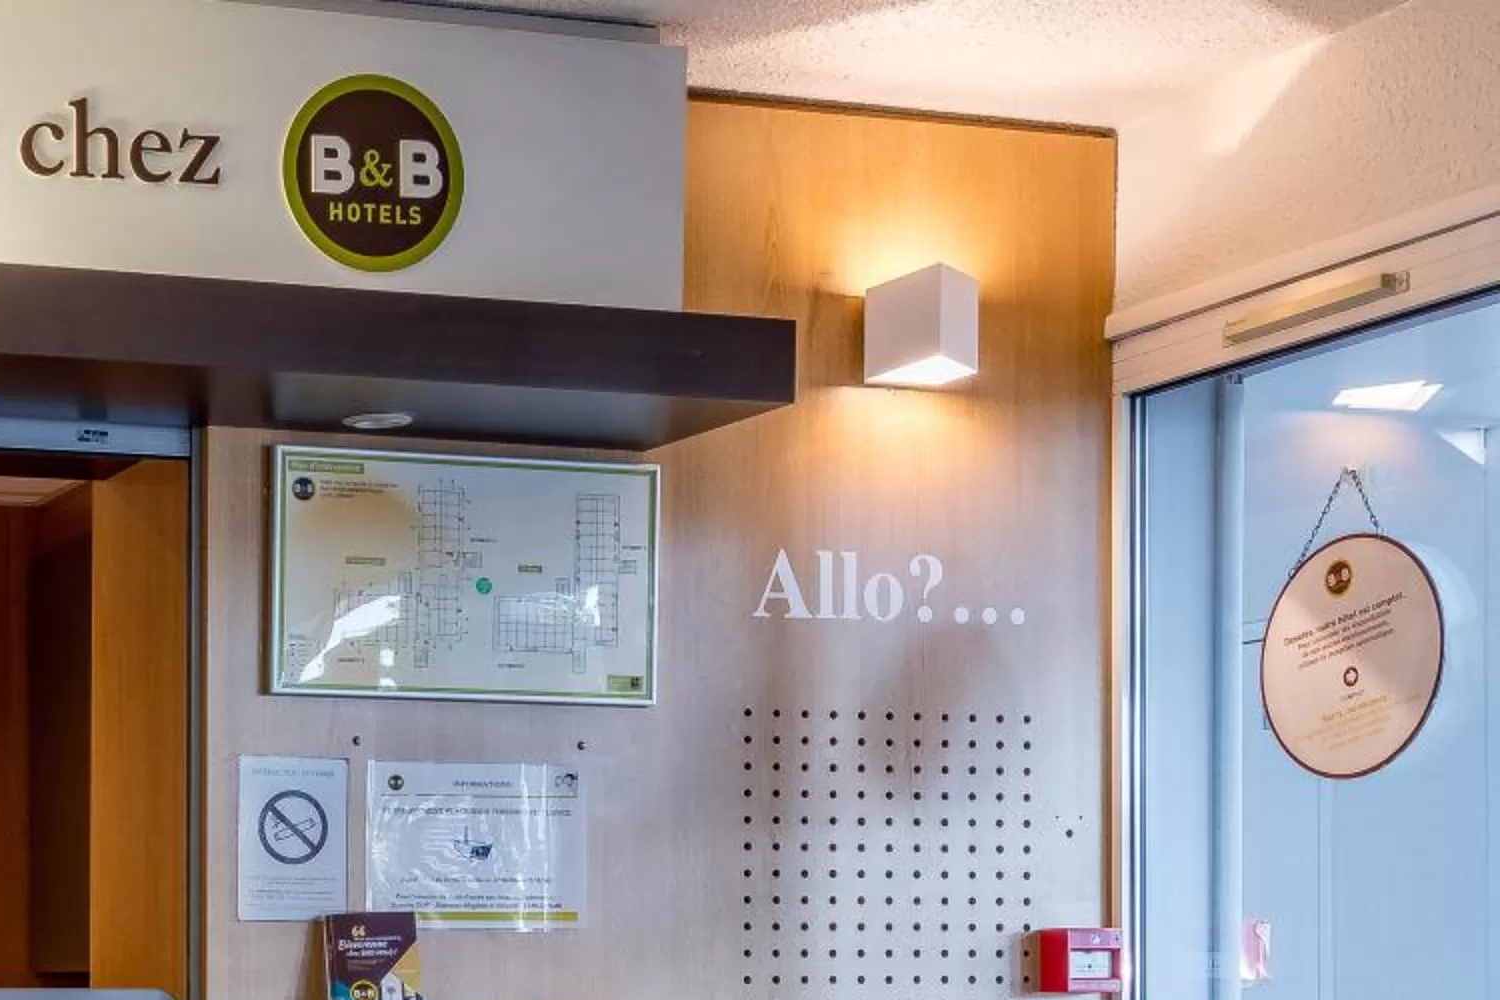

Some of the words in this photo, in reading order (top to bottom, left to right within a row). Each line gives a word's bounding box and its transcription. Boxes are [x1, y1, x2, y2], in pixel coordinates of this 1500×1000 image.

[20, 98, 222, 186] chez
[311, 133, 443, 199] B&B
[329, 201, 422, 225] HOTELS
